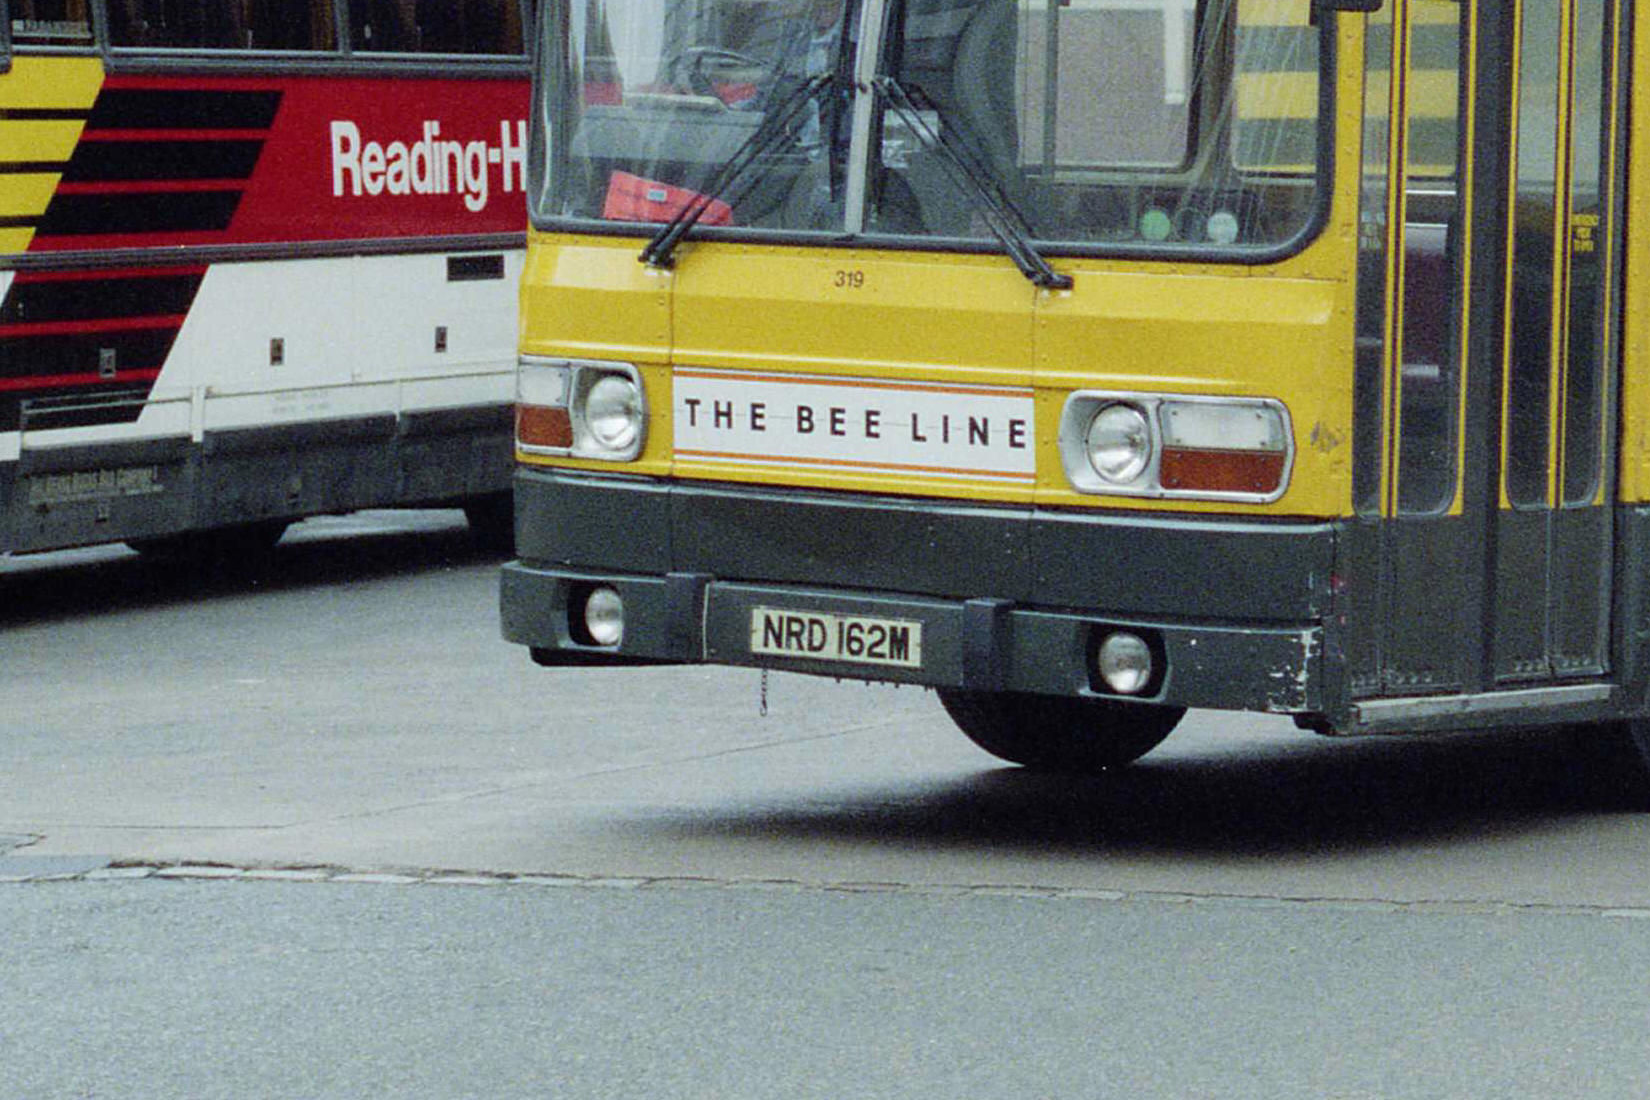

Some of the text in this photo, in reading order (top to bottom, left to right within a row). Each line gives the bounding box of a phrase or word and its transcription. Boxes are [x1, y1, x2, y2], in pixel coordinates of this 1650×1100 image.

[834, 269, 864, 289] 319
[684, 398, 1027, 449] THE BEE LINE
[763, 614, 911, 662] NRD 162M
